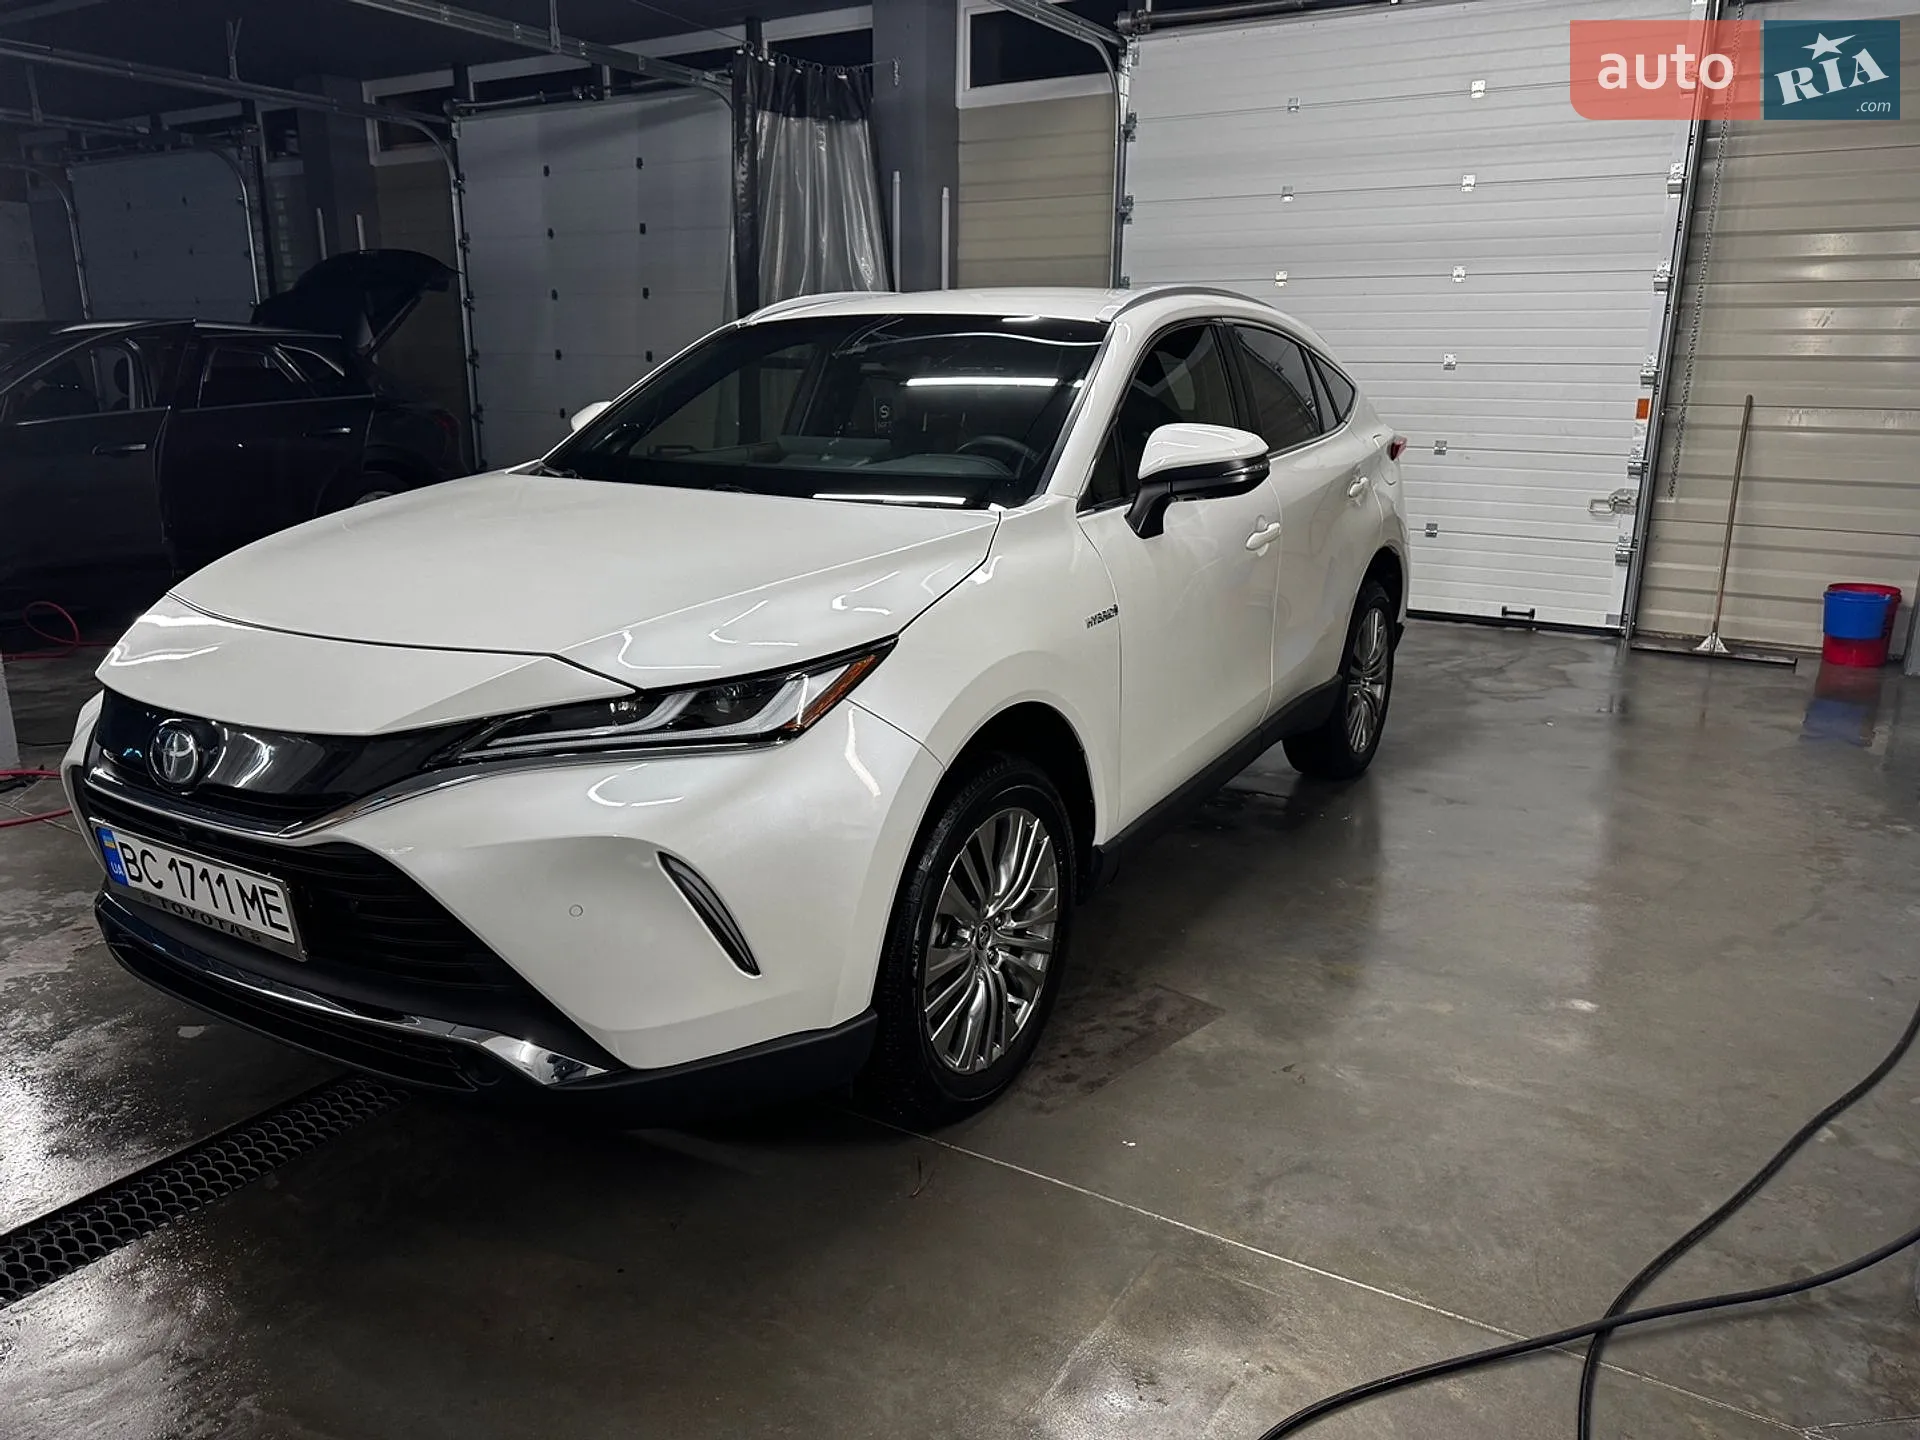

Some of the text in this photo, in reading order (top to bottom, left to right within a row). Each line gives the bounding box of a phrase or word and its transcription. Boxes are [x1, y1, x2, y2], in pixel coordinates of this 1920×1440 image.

[110, 861, 124, 876] UA
[117, 842, 290, 933] BC 1711 ME
[159, 898, 244, 937] TOYOTA
